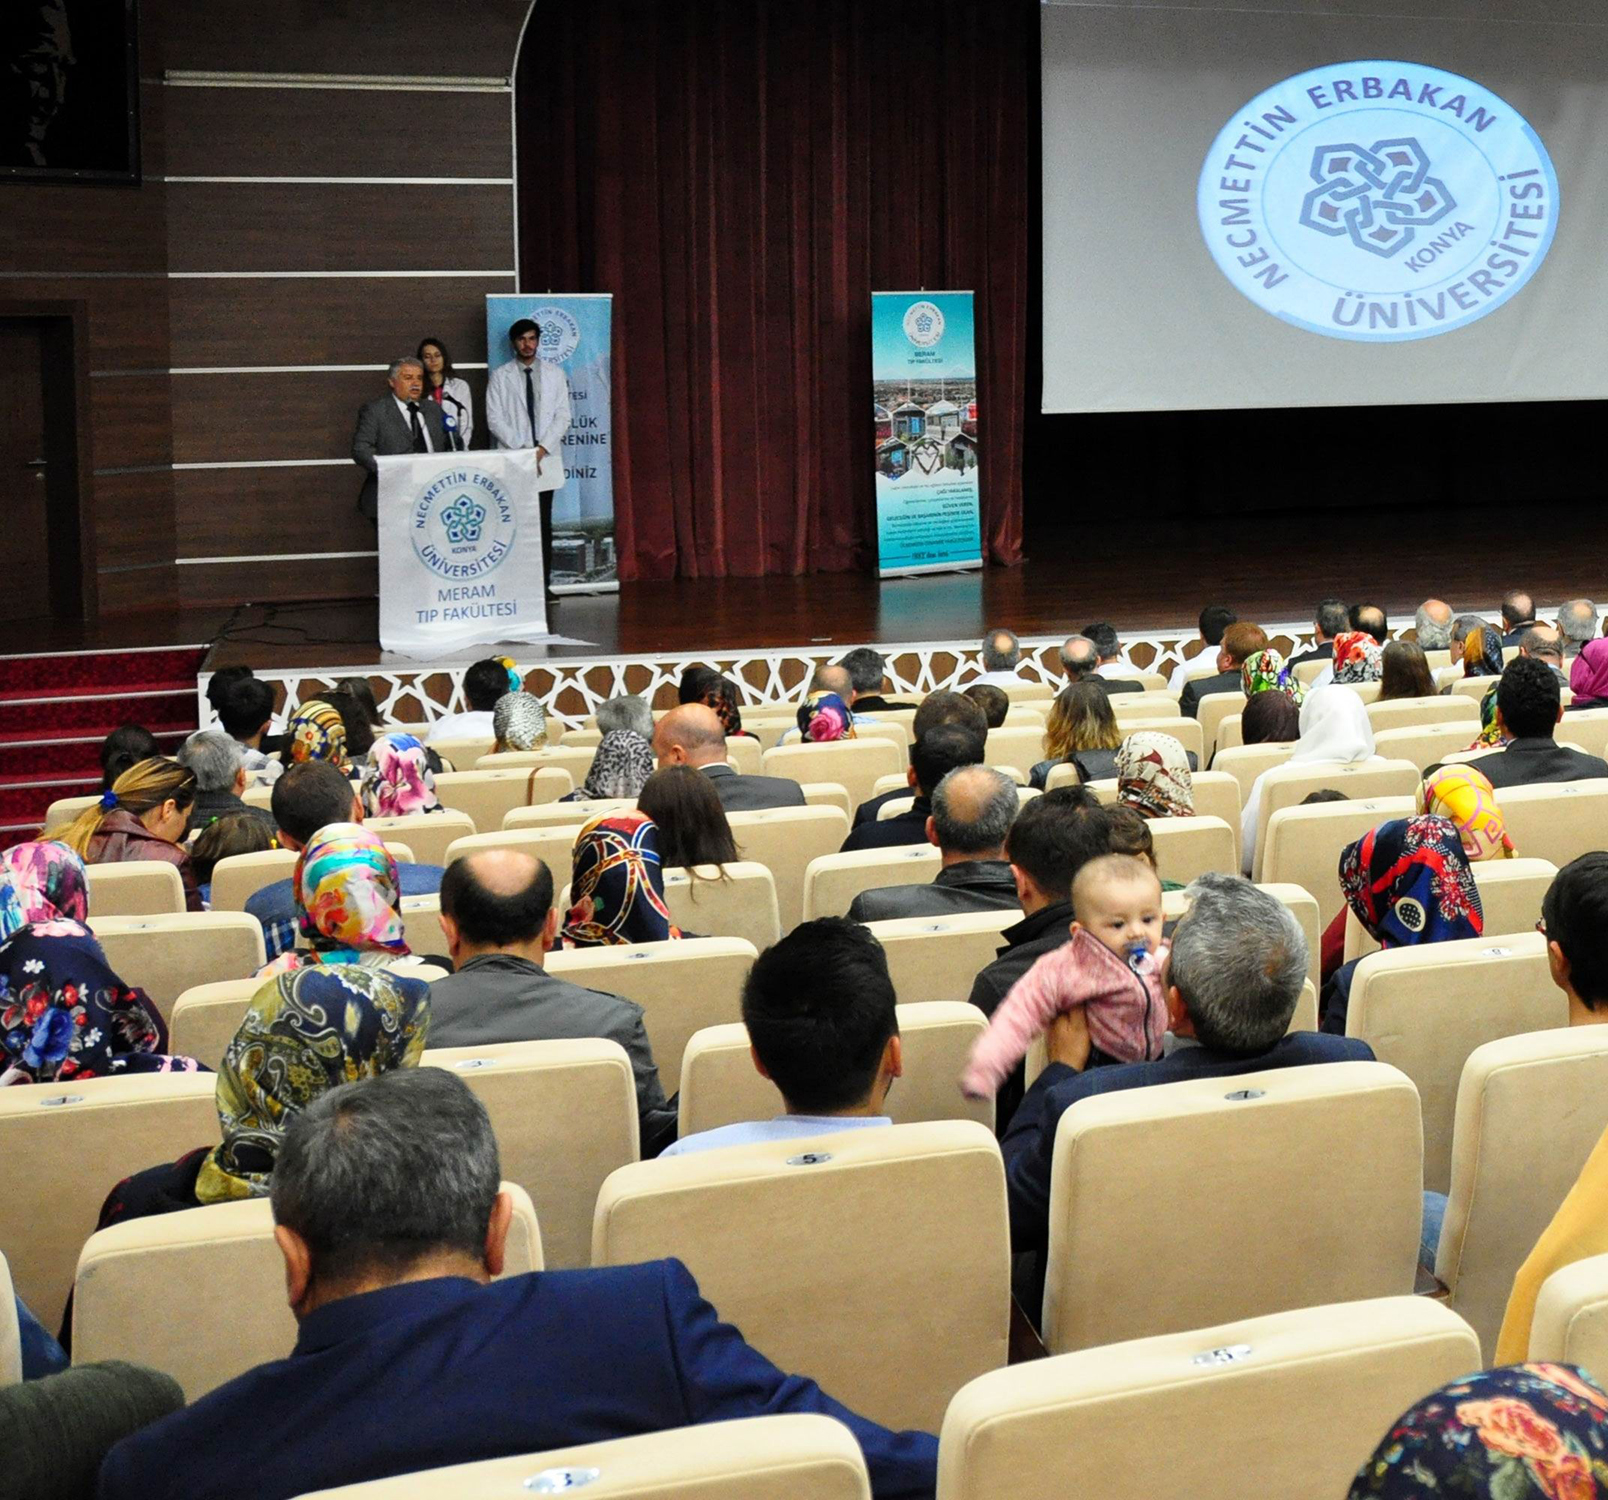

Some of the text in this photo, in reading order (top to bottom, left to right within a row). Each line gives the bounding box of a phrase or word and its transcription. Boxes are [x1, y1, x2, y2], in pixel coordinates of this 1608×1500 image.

[1219, 77, 1497, 290] NECMETTİN ERBAKAN
[1332, 168, 1544, 329] ÜNİVERSİTESİ
[1404, 221, 1475, 273] KONYA
[568, 415, 597, 429] LÜK
[561, 431, 607, 446] RENİNE
[563, 465, 597, 480] DİNİZ
[415, 471, 511, 529] NECMETTİN ERBAKAN
[421, 539, 507, 577] ÜNİVERSİTESİ
[438, 584, 496, 602] MERAM
[416, 599, 517, 623] TIP FAKÜLTESİ
